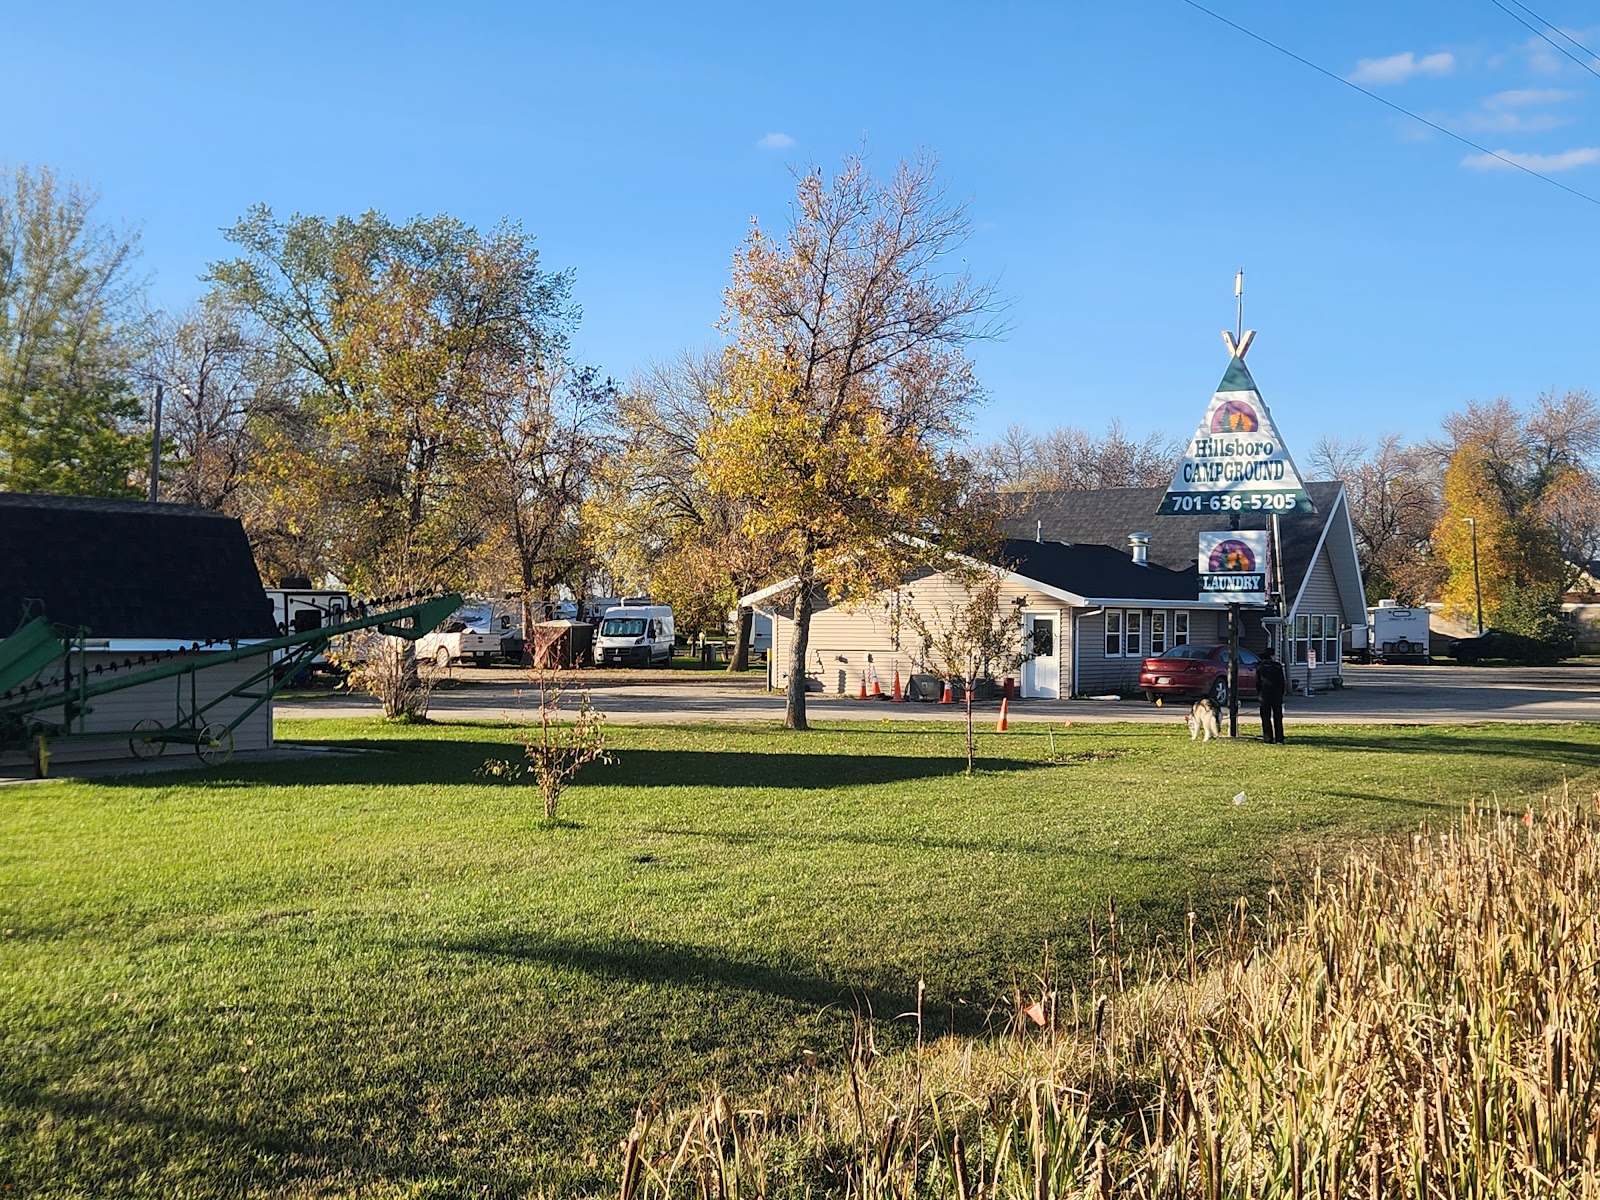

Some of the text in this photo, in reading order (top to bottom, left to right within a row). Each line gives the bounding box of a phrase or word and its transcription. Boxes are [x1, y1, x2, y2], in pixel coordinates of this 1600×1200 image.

[1194, 437, 1274, 458] Hillsboro
[1183, 460, 1285, 483] CAMPGROUND
[1172, 493, 1297, 512] 701-636-5205
[1203, 575, 1261, 591] LAUNDRY
